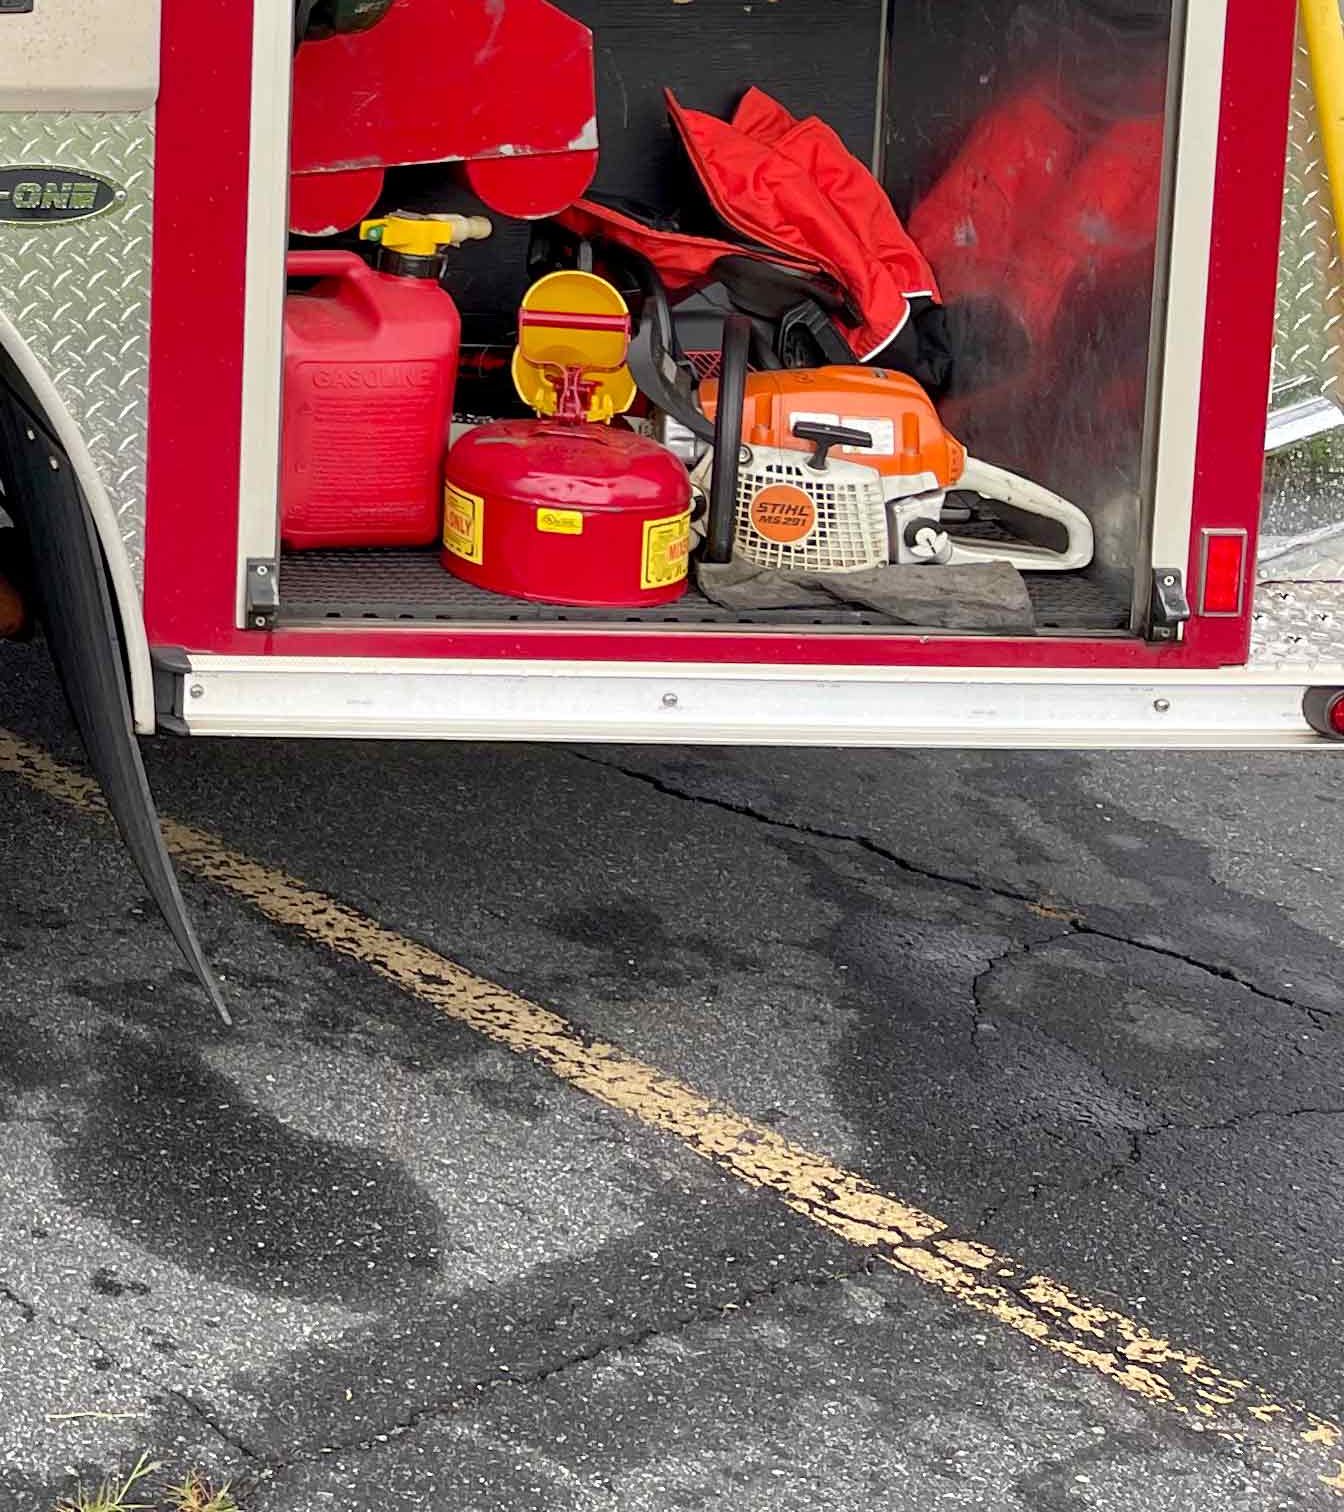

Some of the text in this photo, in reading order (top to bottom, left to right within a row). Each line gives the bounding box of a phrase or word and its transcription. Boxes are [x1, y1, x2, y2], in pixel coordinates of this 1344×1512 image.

[312, 367, 433, 389] GASOLINE
[756, 502, 809, 517] STIHL
[449, 510, 473, 538] ONLY
[782, 517, 806, 527] 291
